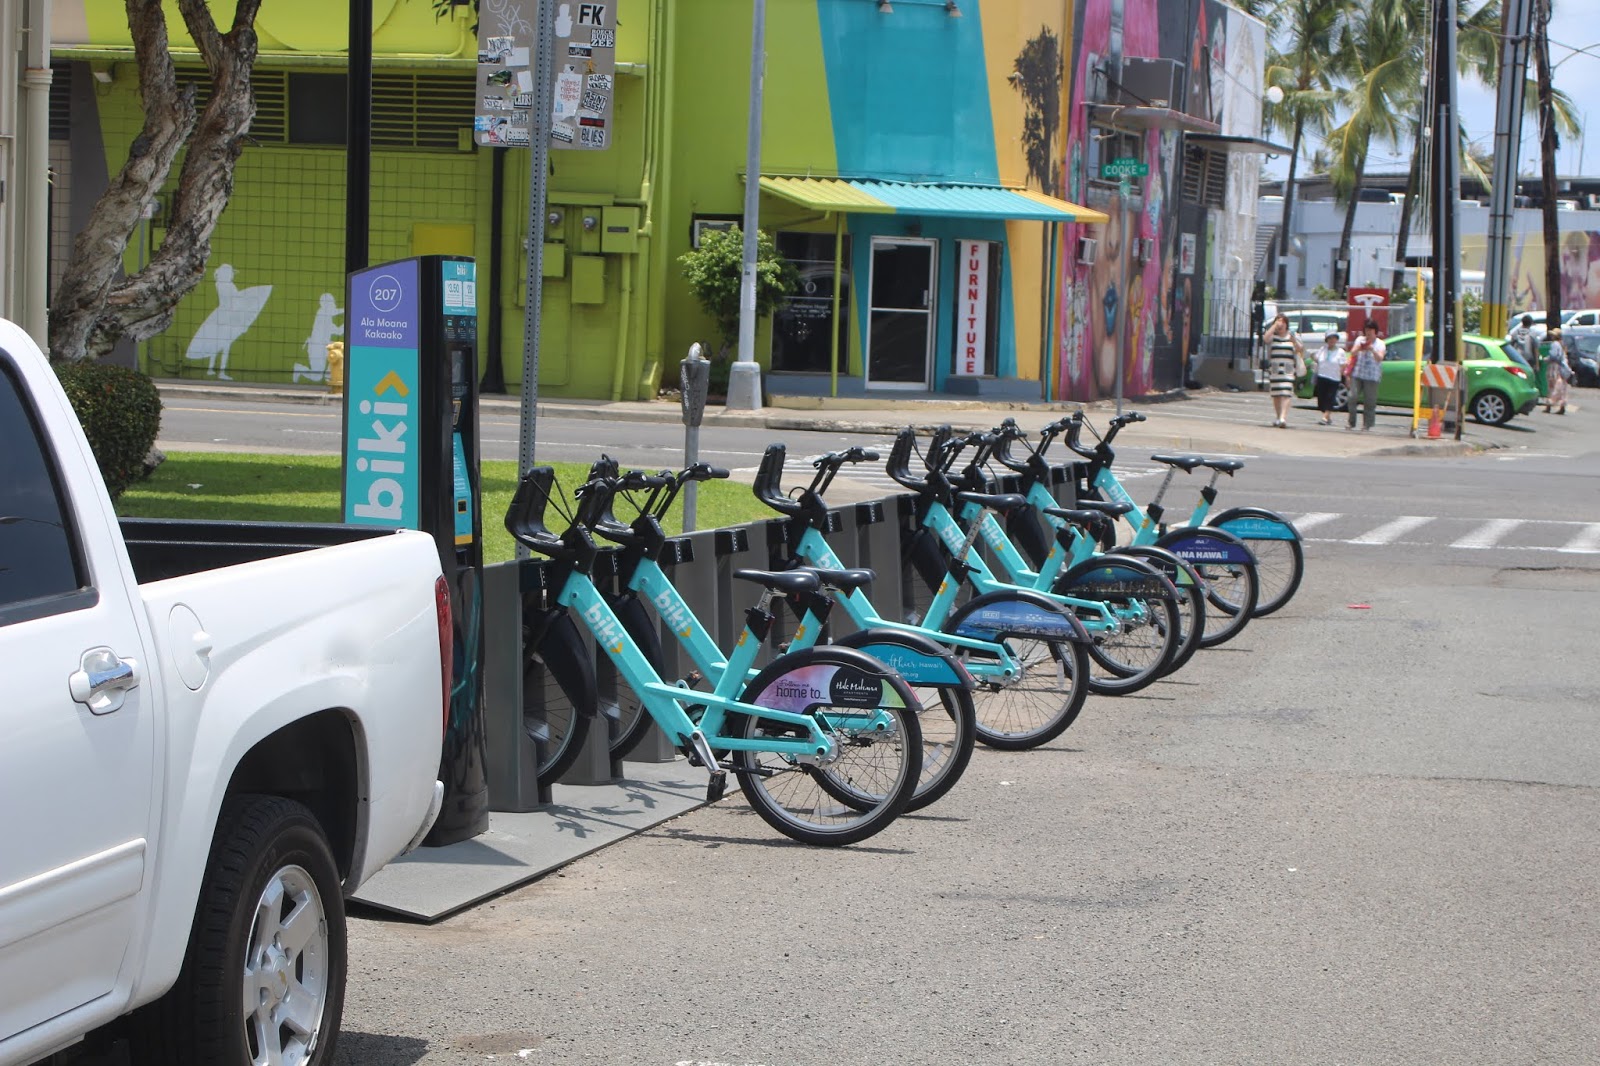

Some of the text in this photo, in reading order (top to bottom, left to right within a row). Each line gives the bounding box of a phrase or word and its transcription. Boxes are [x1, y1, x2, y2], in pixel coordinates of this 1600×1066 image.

[579, 4, 604, 25] FK
[591, 39, 613, 47] ZEE
[1105, 165, 1137, 175] COOKE
[375, 289, 397, 300] 207
[966, 245, 979, 373] FURNITURE
[361, 317, 407, 328] Ala Moana
[365, 329, 402, 339] Kakaako
[354, 399, 408, 520] biki
[1176, 551, 1194, 559] ANA
[654, 589, 692, 631] biki
[584, 602, 624, 648] biki
[776, 686, 809, 699] home
